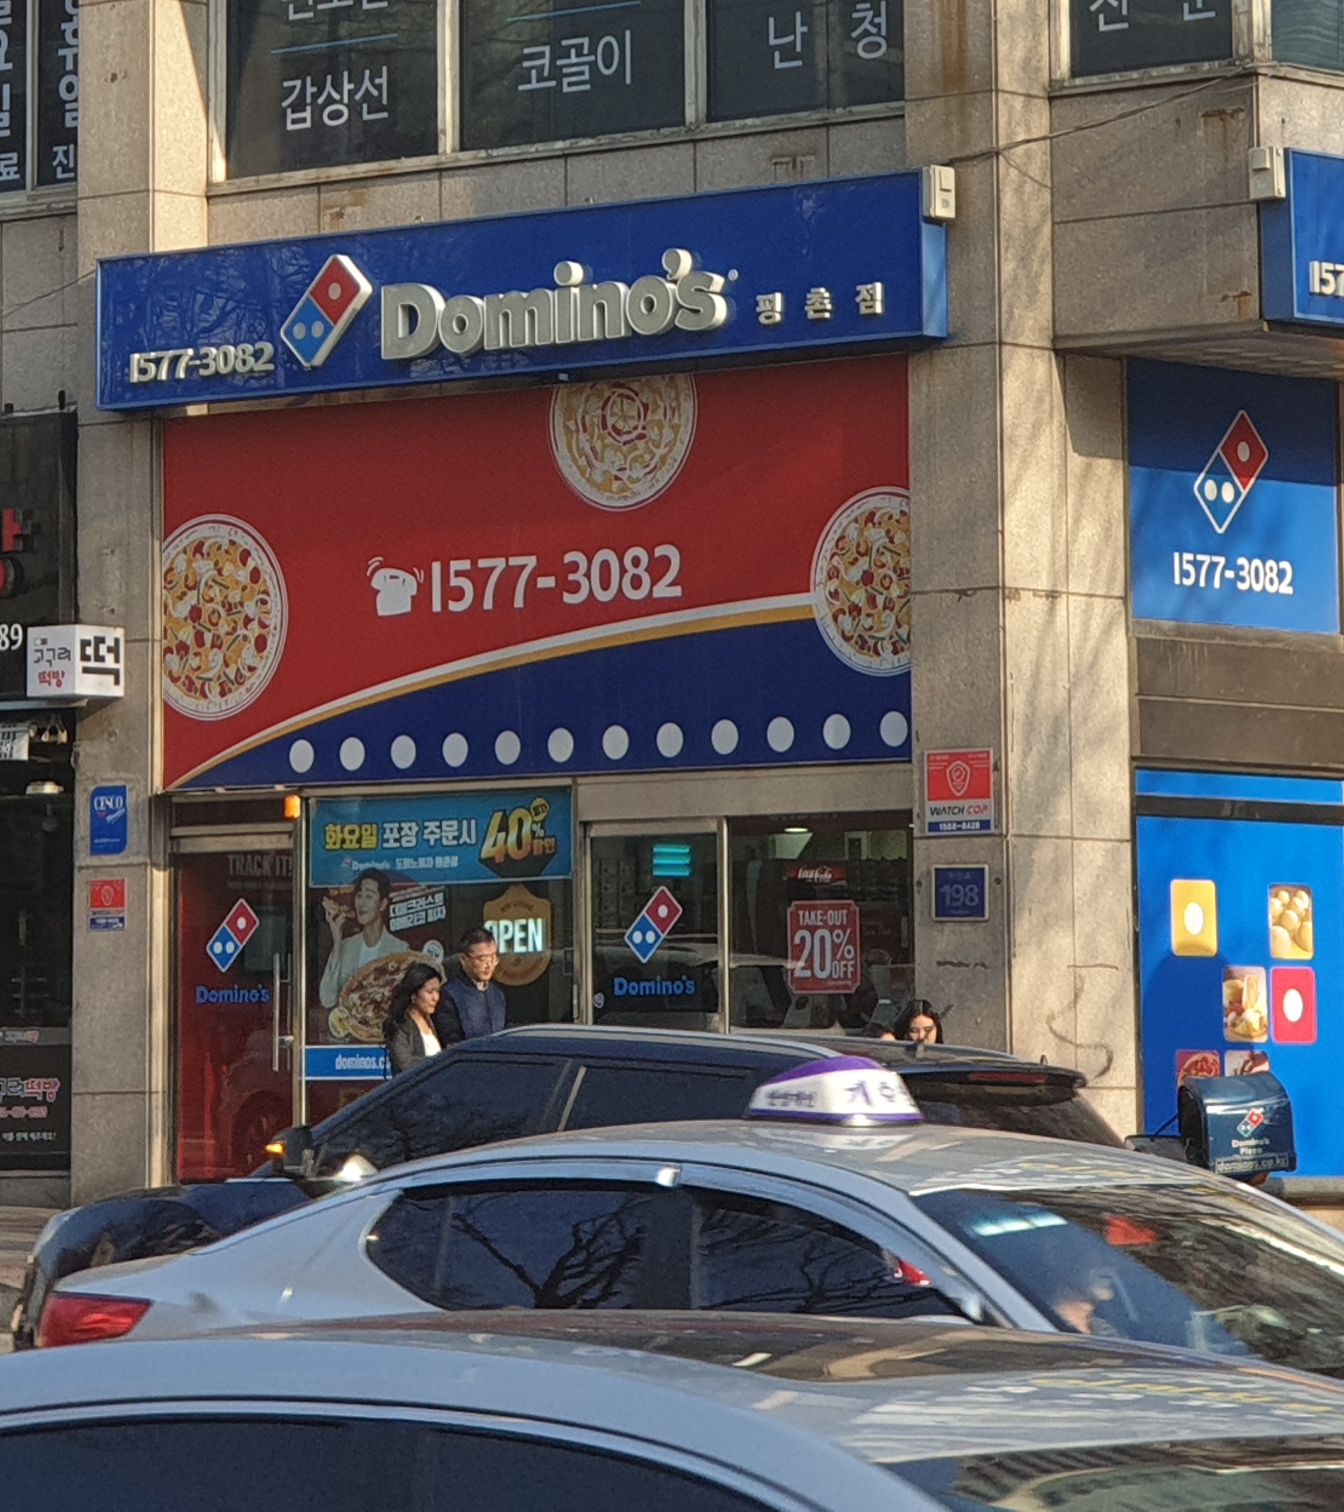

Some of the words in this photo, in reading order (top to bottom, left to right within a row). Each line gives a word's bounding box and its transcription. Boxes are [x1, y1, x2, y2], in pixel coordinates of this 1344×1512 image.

[517, 28, 633, 93] 코골이
[280, 65, 390, 132] 갑상선
[130, 341, 275, 384] 1577-3082
[378, 247, 732, 363] Domino's
[755, 281, 885, 326] 평촌점
[430, 543, 682, 613] 1577-3082
[1172, 549, 1295, 595] 1577-3082
[32, 643, 73, 665] 고구려
[79, 634, 122, 687] 떡
[37, 669, 66, 689] 떡방
[929, 805, 965, 816] WATCH
[966, 804, 989, 816] COP
[323, 822, 378, 851] 화요일
[381, 820, 420, 849] 포장
[423, 819, 477, 848] 주문시
[228, 854, 273, 878] TRACK
[940, 883, 980, 907] 198
[798, 909, 849, 926] TAKE-OUT
[831, 960, 855, 979] OFF
[195, 984, 270, 1005] Domino's
[613, 974, 697, 998] Domino's
